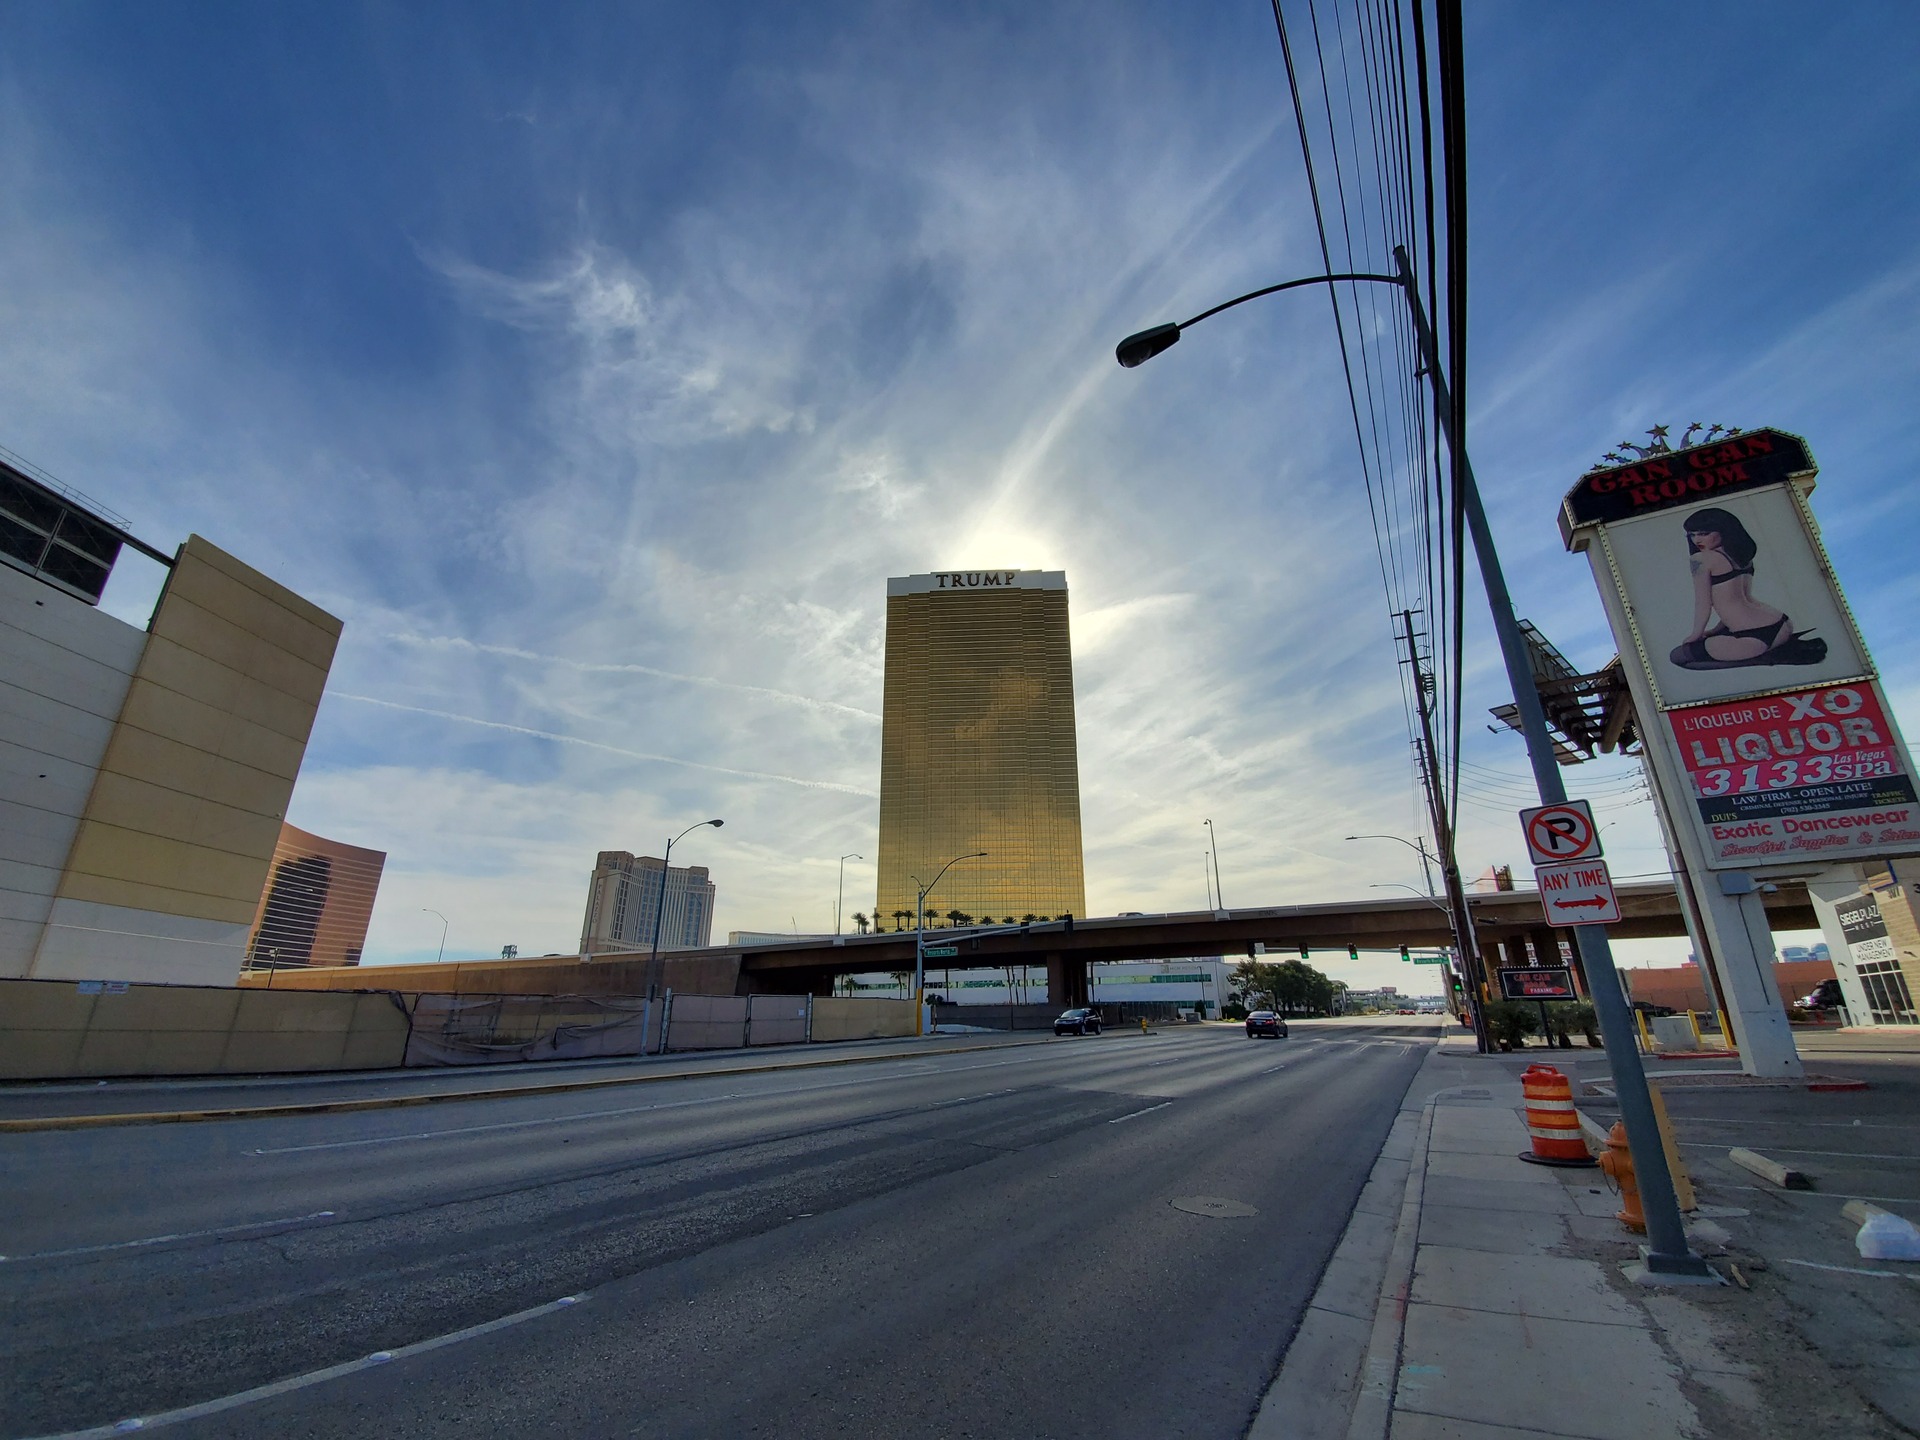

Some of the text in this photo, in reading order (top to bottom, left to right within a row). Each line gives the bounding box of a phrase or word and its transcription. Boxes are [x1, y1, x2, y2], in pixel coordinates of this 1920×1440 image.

[1629, 463, 1752, 507] ROOM
[935, 571, 1016, 588] TRUMP
[1758, 705, 1782, 721] DE
[1782, 688, 1863, 722] XO
[1690, 716, 1881, 768] LIQUOR
[1833, 749, 1886, 765] Las Vegas
[1701, 755, 1833, 797] 3133
[1731, 795, 1758, 806] LAW
[1760, 791, 1792, 802] FIRM
[1799, 786, 1835, 798] OPEN
[1836, 782, 1873, 794] LATE!
[1739, 803, 1773, 811] CRIMINAL
[1773, 799, 1802, 807] DEFENSE
[1844, 792, 1869, 801] INJURY
[1711, 812, 1738, 823] DUI'S
[1711, 808, 1911, 841] Exotic Dancewear
[1543, 868, 1607, 892] ANY TIME
[1856, 939, 1888, 953] UNDER NEW
[1856, 947, 1893, 961] MANAGEMENT
